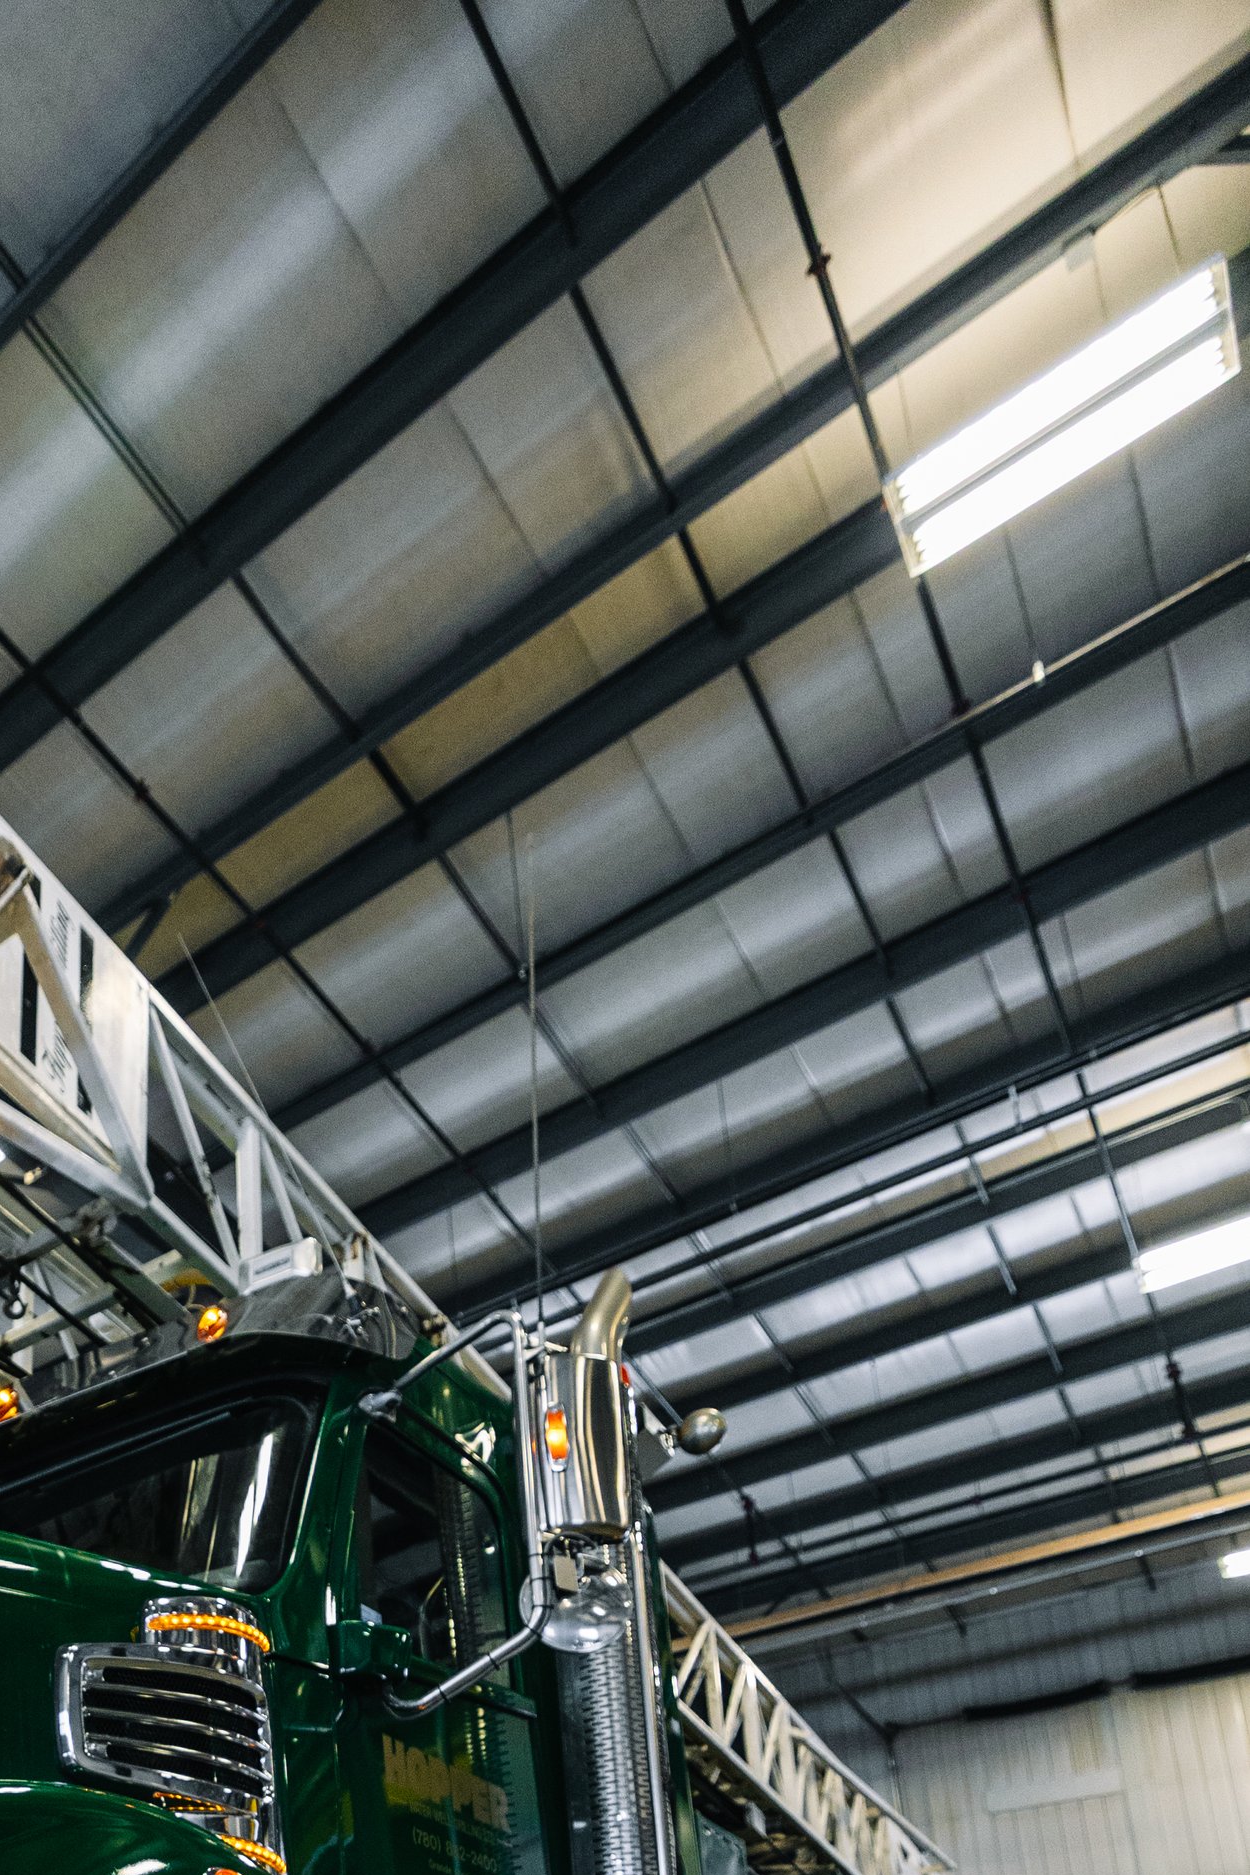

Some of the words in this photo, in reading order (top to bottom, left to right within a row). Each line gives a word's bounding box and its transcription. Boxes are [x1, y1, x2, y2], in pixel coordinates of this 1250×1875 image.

[382, 1732, 512, 1835] HOPPER
[412, 1826, 441, 1852] (780)
[445, 1839, 498, 1873] 82-2400
